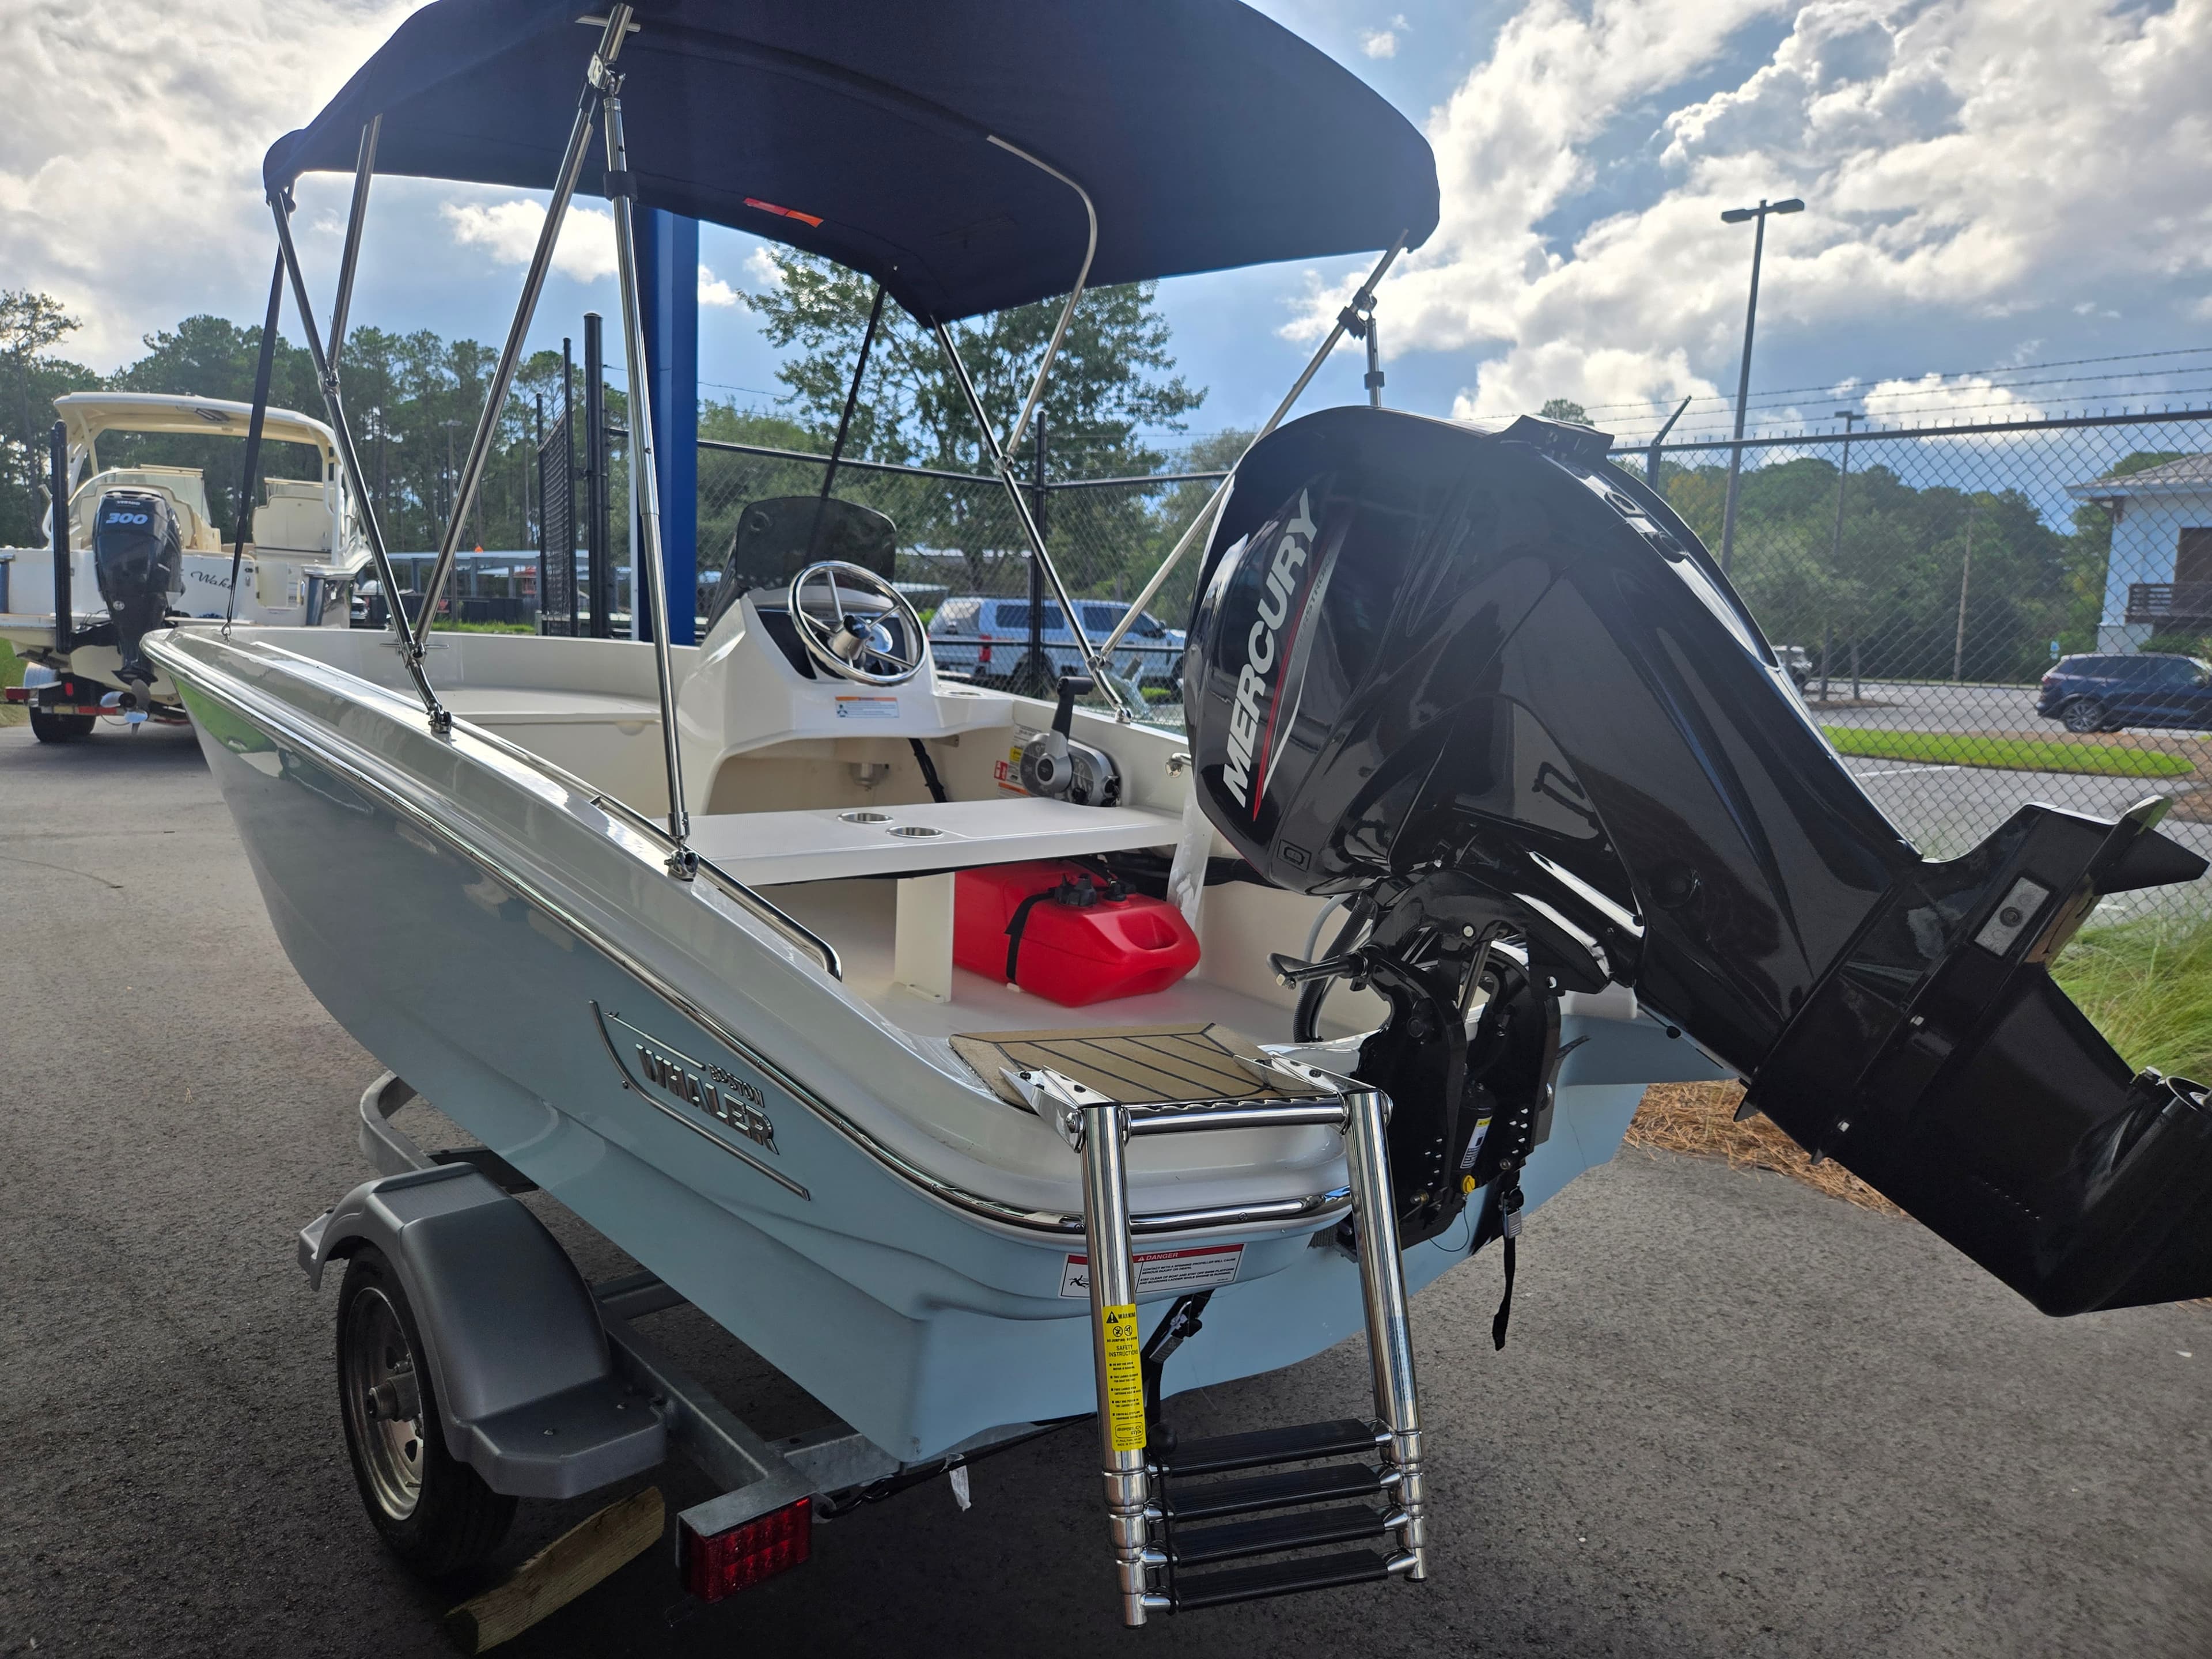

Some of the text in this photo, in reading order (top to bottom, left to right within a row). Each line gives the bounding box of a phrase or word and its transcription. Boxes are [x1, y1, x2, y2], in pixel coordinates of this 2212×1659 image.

[106, 513, 148, 524] 300
[1223, 488, 1317, 808] MERCURY
[636, 1043, 779, 1154] WHALER
[709, 1063, 764, 1108] BOSTON
[1146, 1252, 1179, 1261] DANGER
[1108, 1349, 1138, 1357] INSTRUCTIONS
